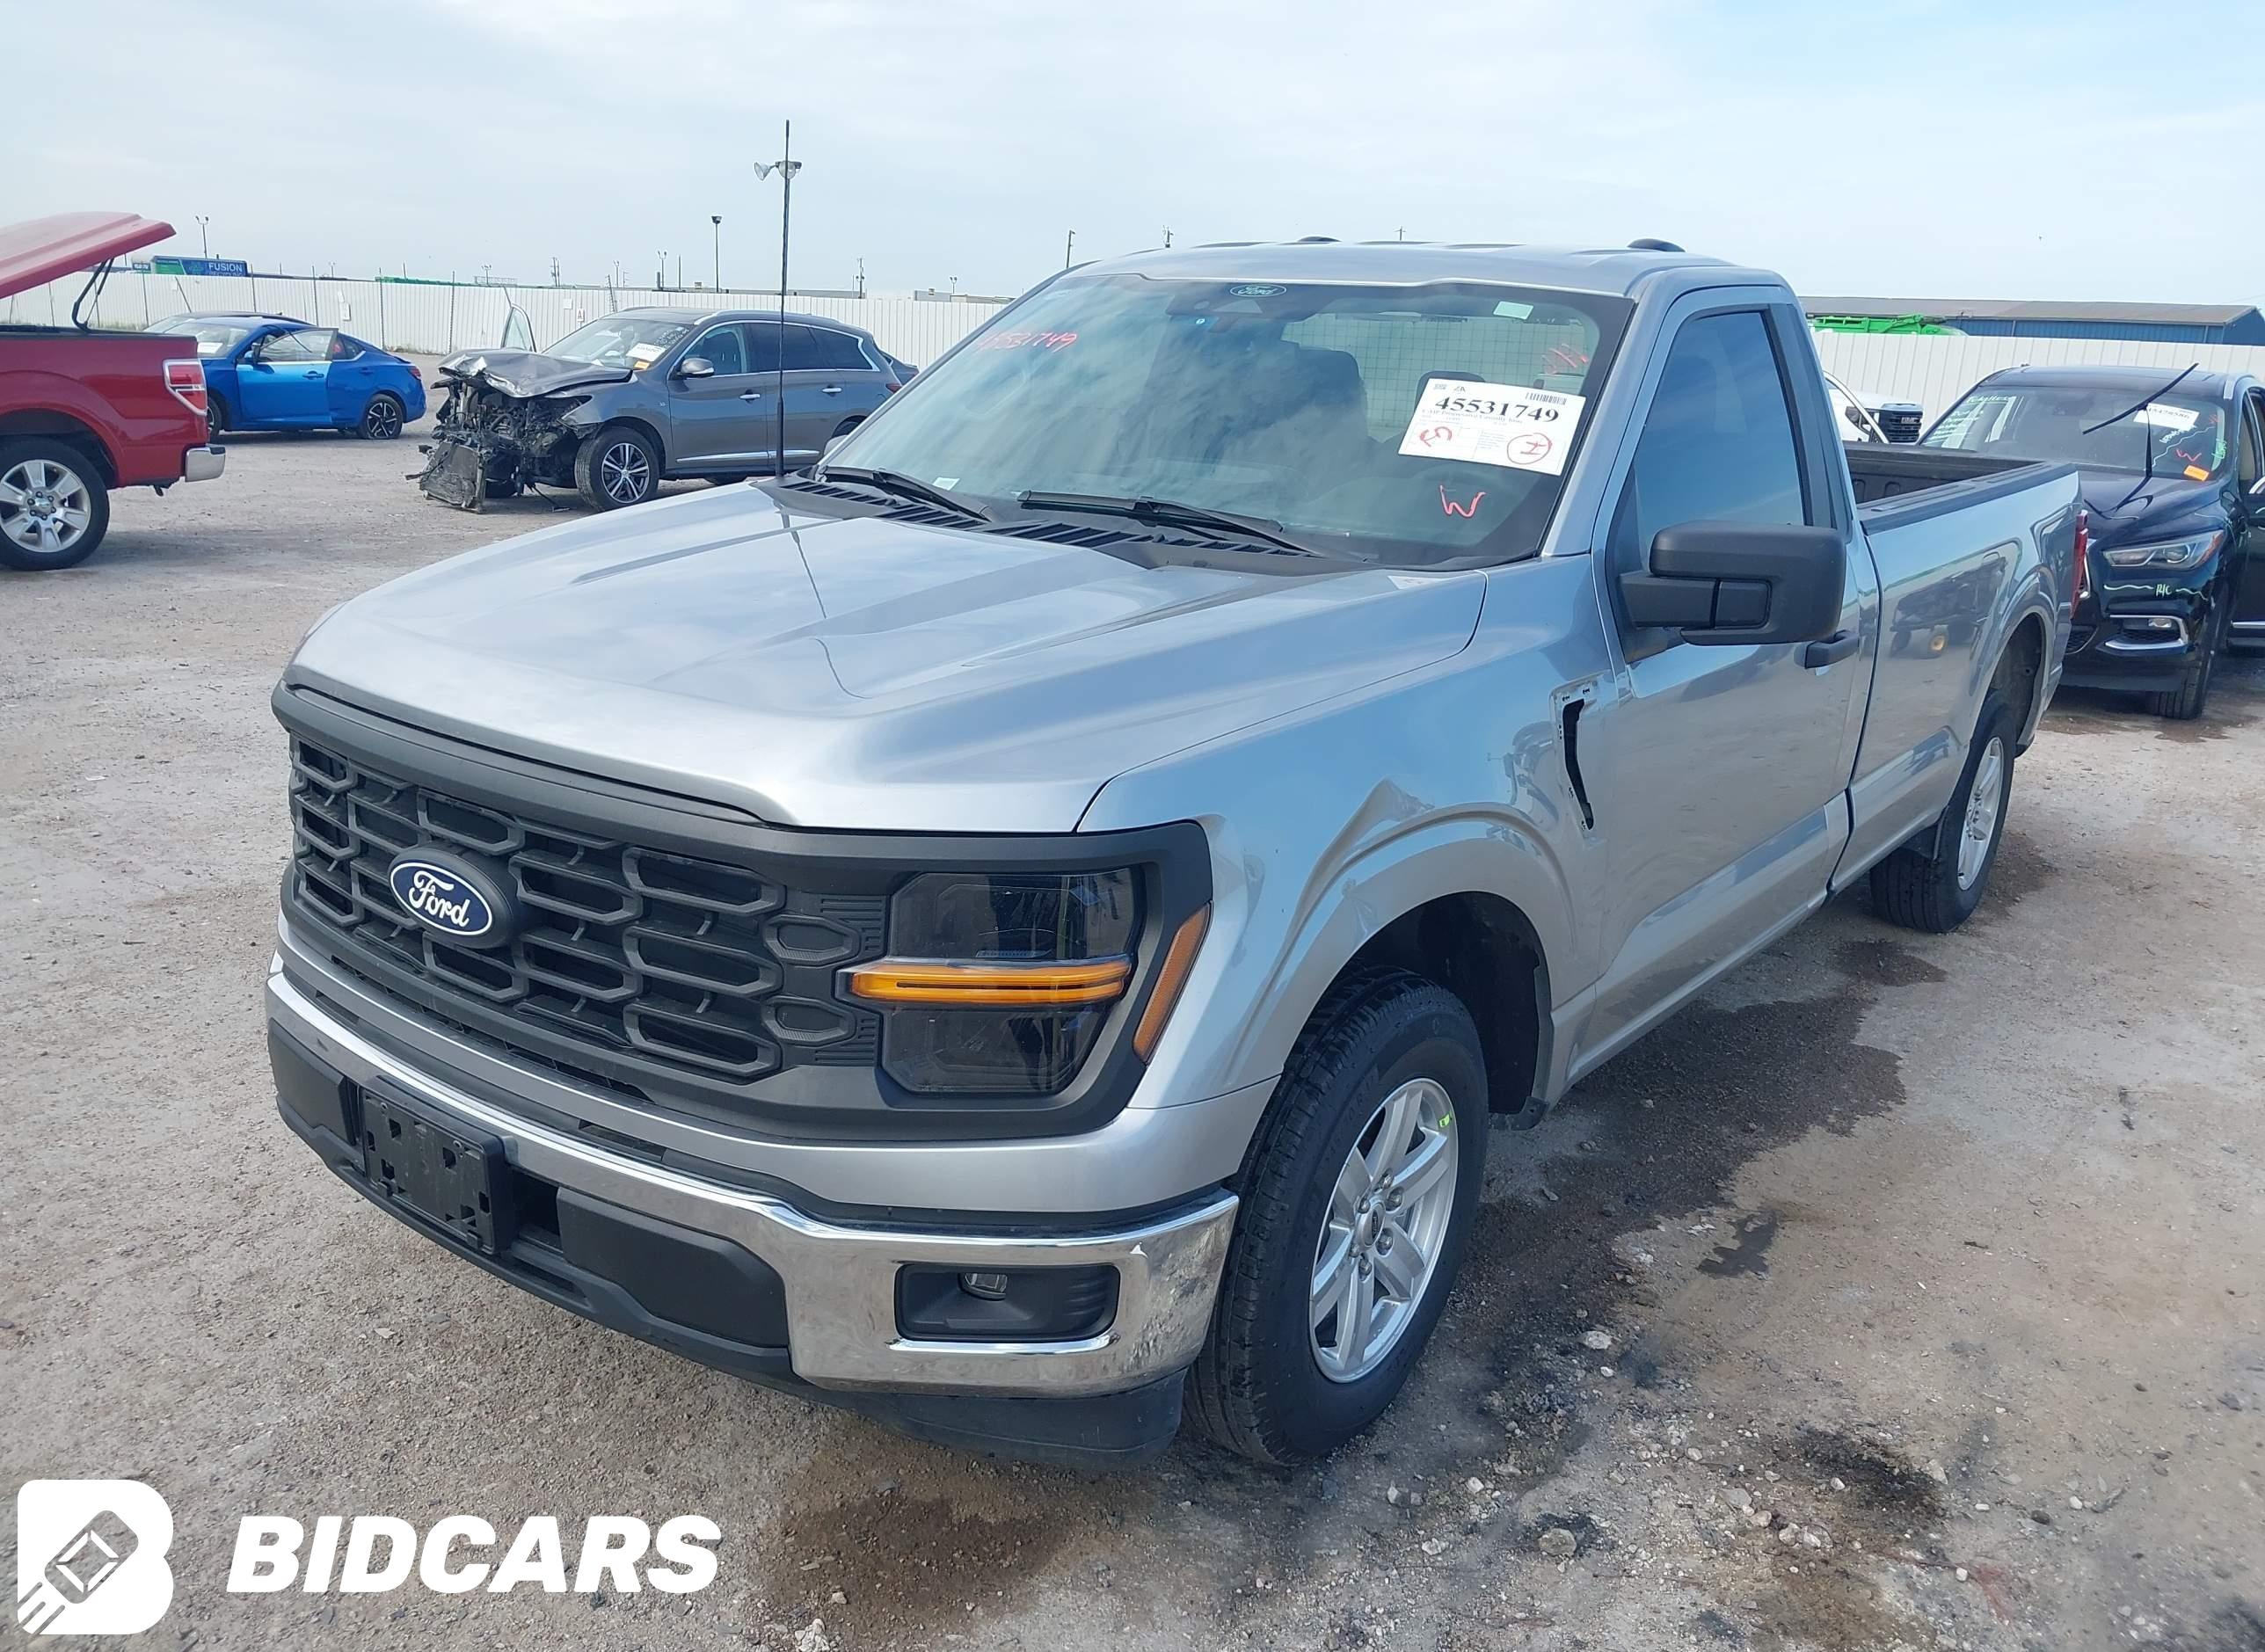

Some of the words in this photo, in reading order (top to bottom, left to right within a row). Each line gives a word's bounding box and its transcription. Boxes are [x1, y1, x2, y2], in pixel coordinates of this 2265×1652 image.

[208, 263, 243, 273] FUSION
[1435, 397, 1559, 423] 45531749
[1438, 484, 1486, 518] W
[408, 870, 471, 928] Ford
